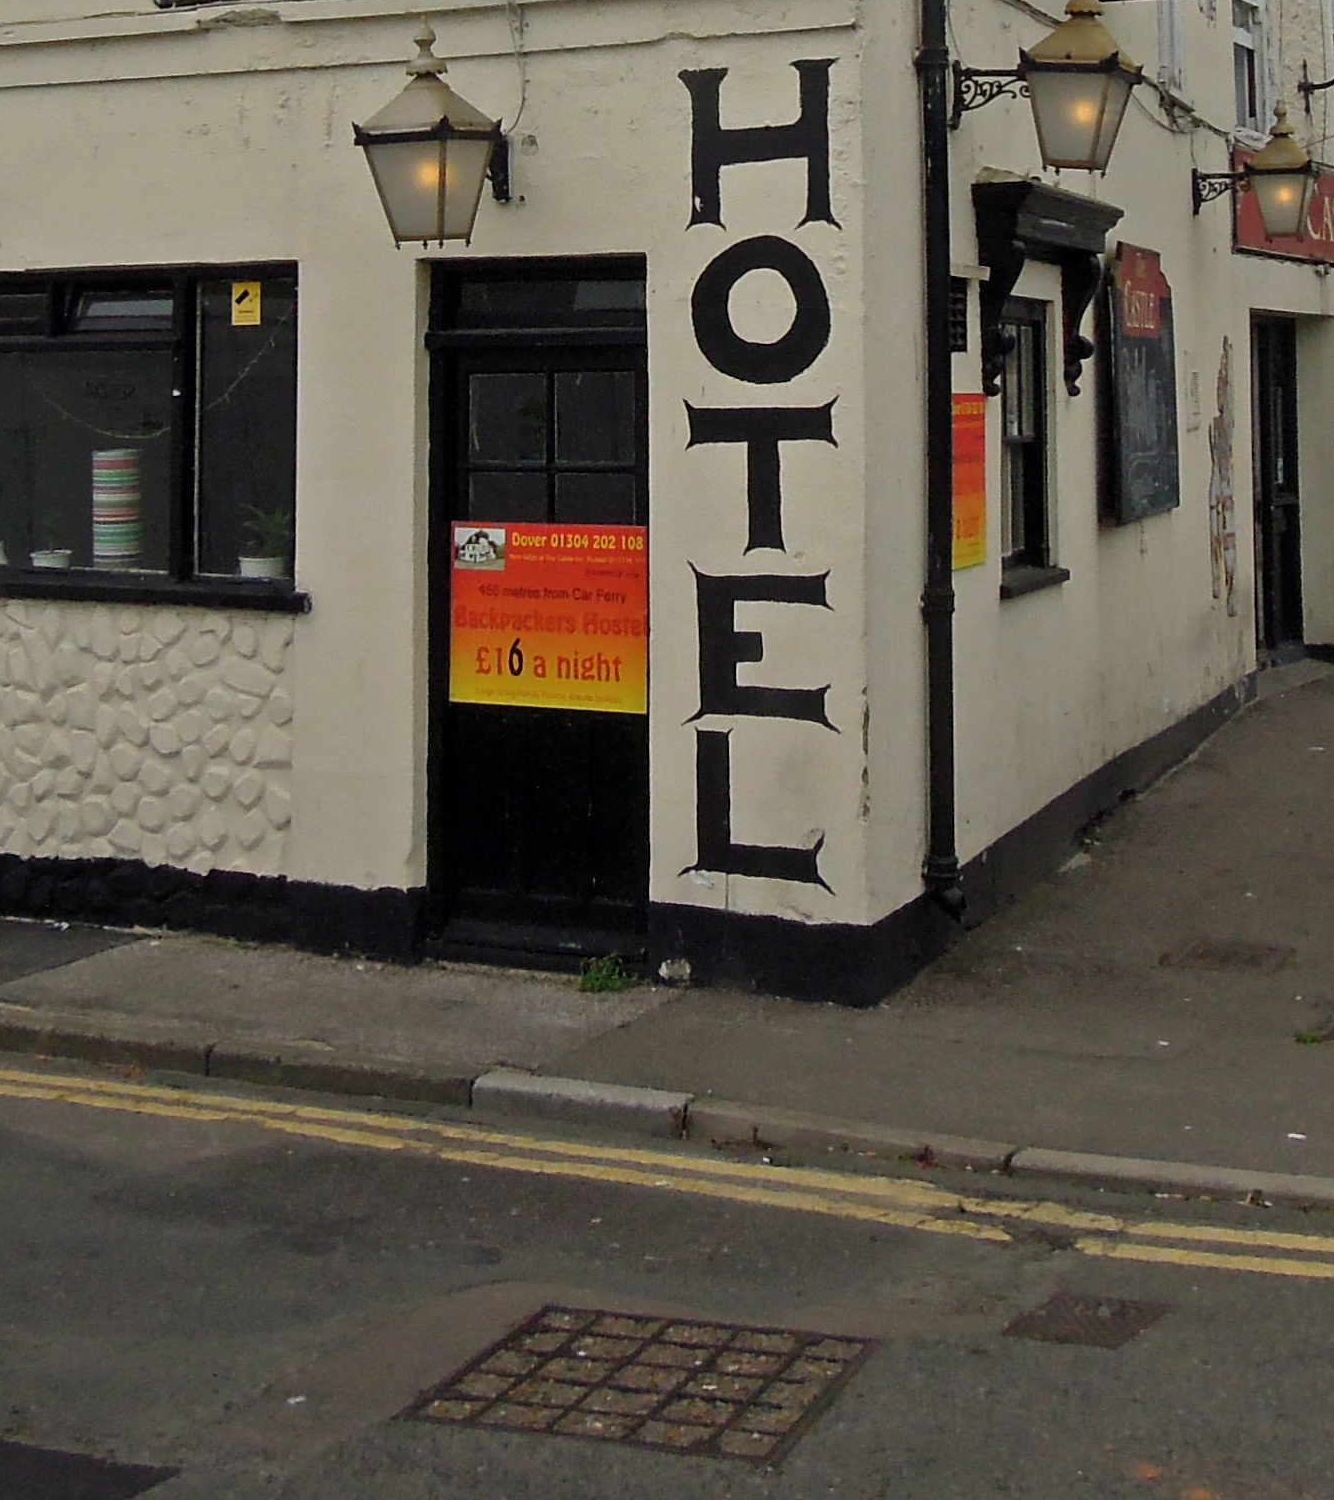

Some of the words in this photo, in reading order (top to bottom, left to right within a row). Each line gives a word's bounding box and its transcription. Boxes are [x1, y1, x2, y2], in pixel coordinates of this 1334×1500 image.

[1125, 279, 1156, 329] CASTLE
[677, 58, 842, 895] HOTEL
[513, 532, 547, 547] Dover
[550, 533, 589, 549] 01304
[593, 534, 616, 550] 202
[621, 535, 644, 551] 108
[502, 586, 540, 600] metres
[543, 586, 569, 600] from
[572, 587, 593, 602] Car
[596, 588, 627, 605] Ferry
[456, 608, 575, 632] Backpackers
[584, 613, 646, 636] Hostel
[476, 638, 524, 677] £16
[533, 658, 548, 679] a
[557, 650, 623, 682] night
